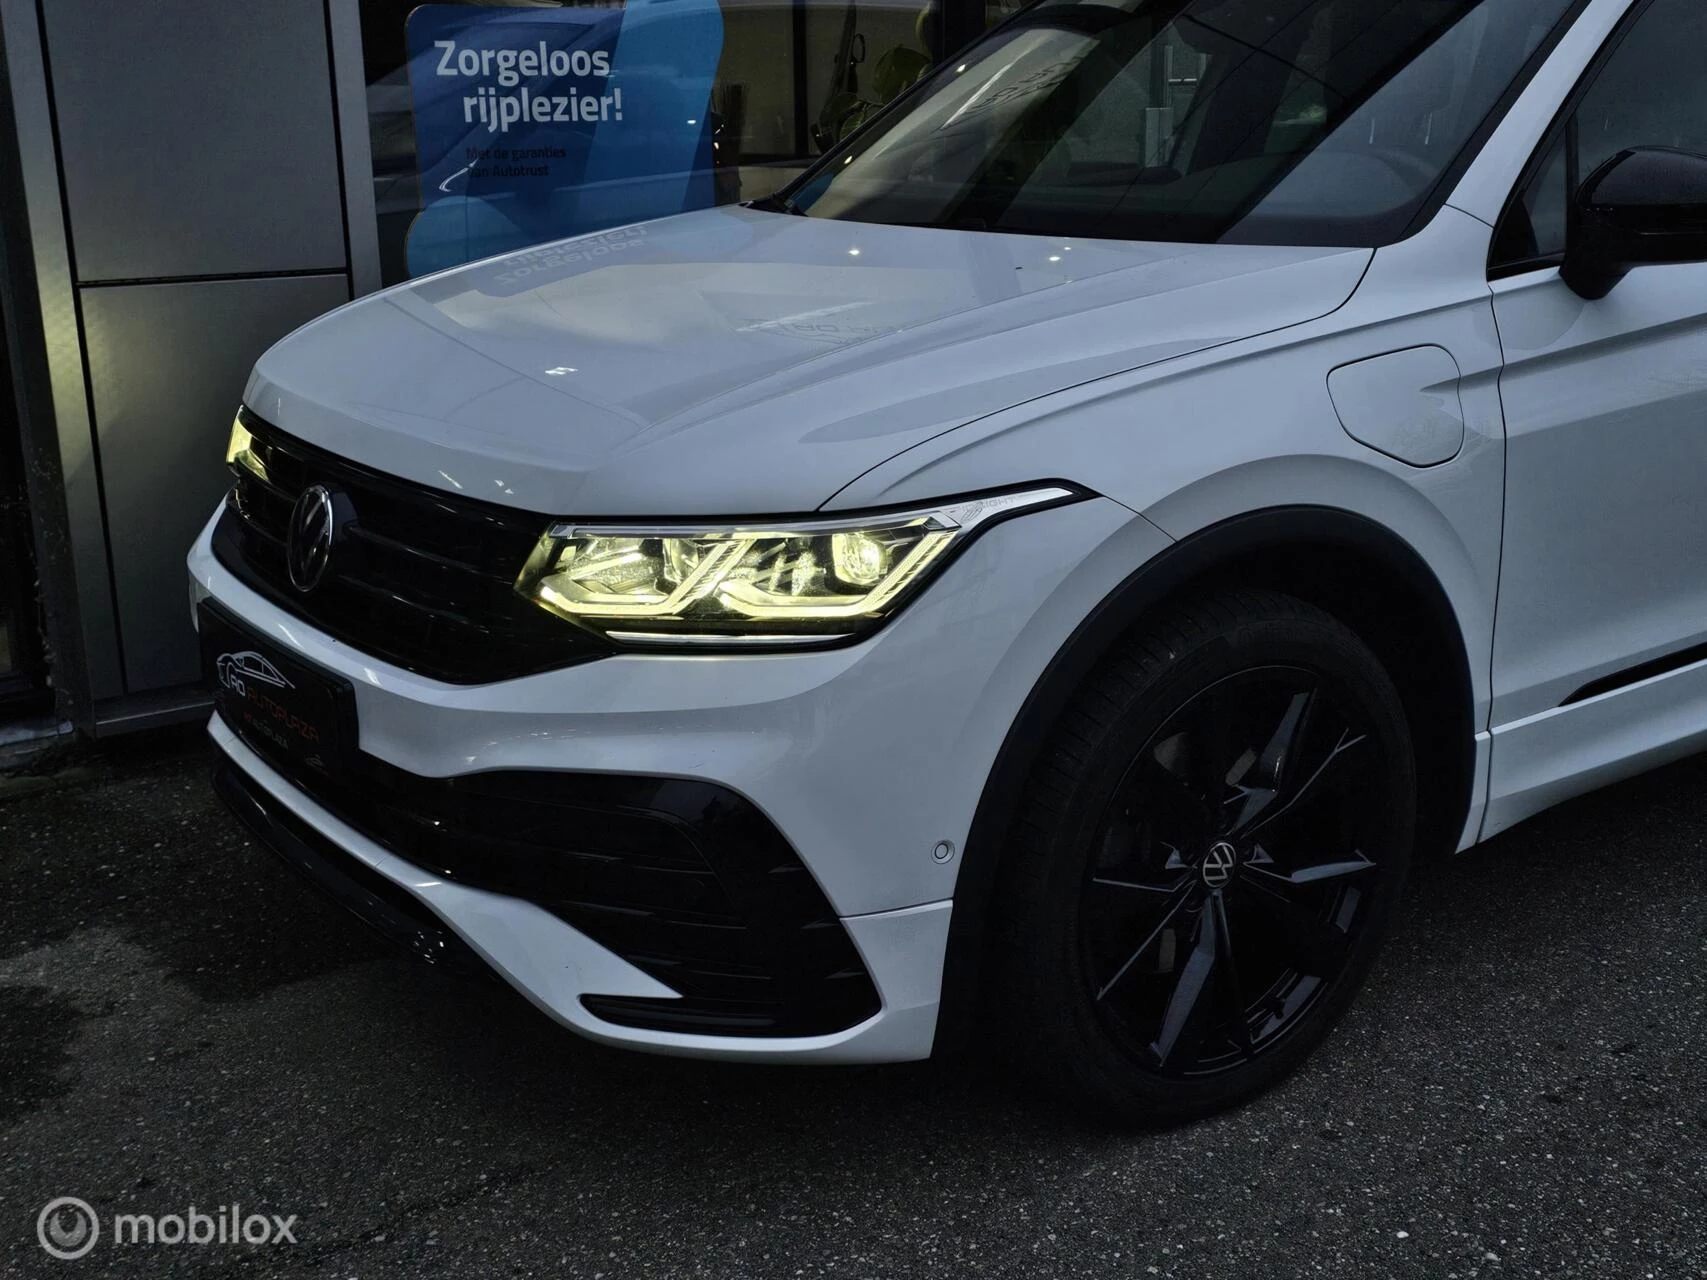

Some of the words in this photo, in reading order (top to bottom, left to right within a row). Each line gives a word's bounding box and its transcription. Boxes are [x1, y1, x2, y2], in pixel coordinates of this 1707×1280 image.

[434, 40, 610, 87] Zorgeloos
[463, 87, 623, 133] rijplezier!
[494, 147, 509, 160] de
[512, 146, 567, 163] garanties
[493, 165, 549, 178] Autotrust
